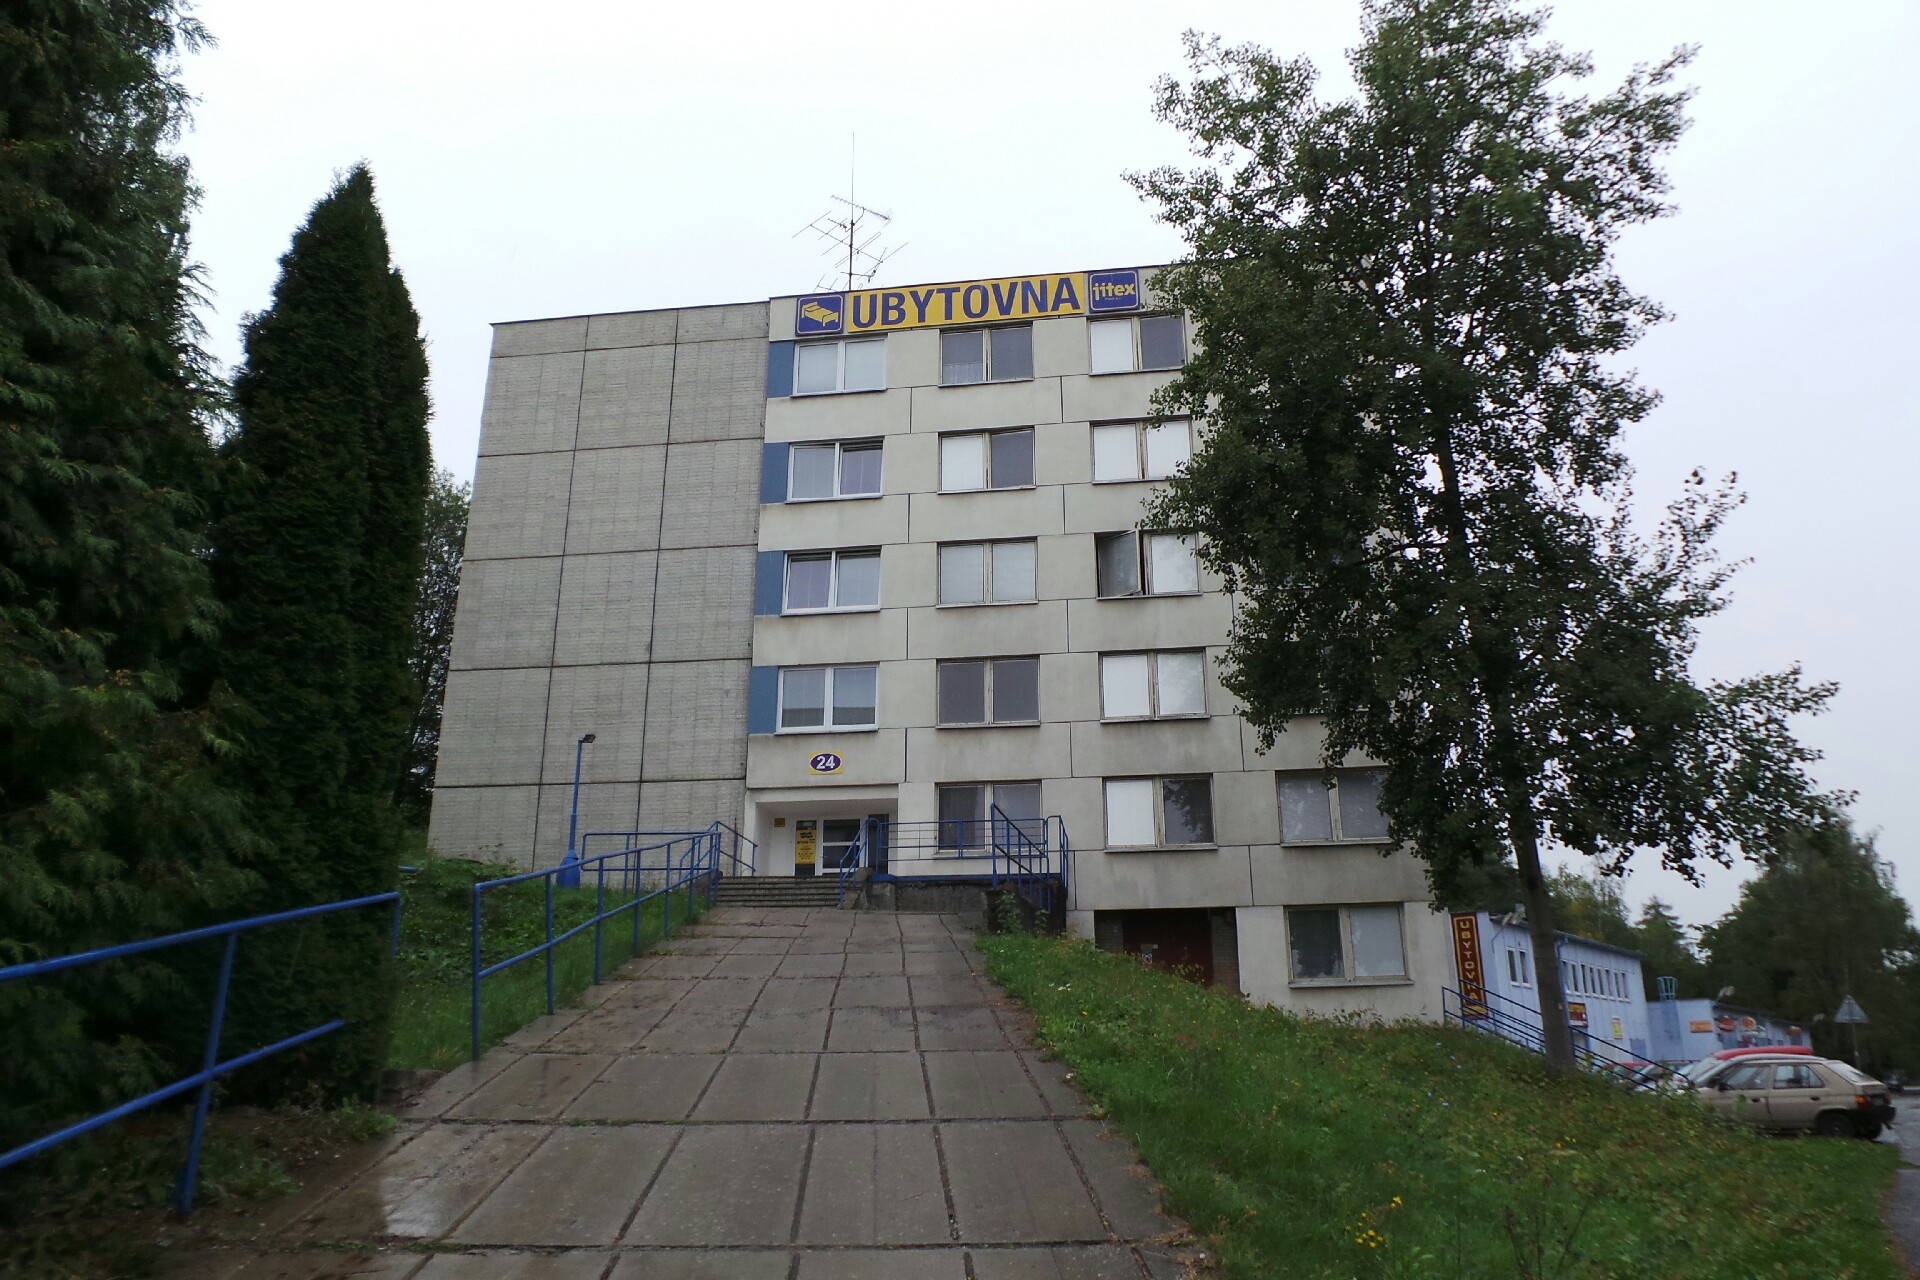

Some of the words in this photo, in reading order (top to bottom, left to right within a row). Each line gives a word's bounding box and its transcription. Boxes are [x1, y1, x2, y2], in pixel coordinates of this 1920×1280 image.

[1092, 282, 1136, 300] jitex
[852, 277, 1081, 329] UBYTOVNA
[816, 755, 835, 769] 24
